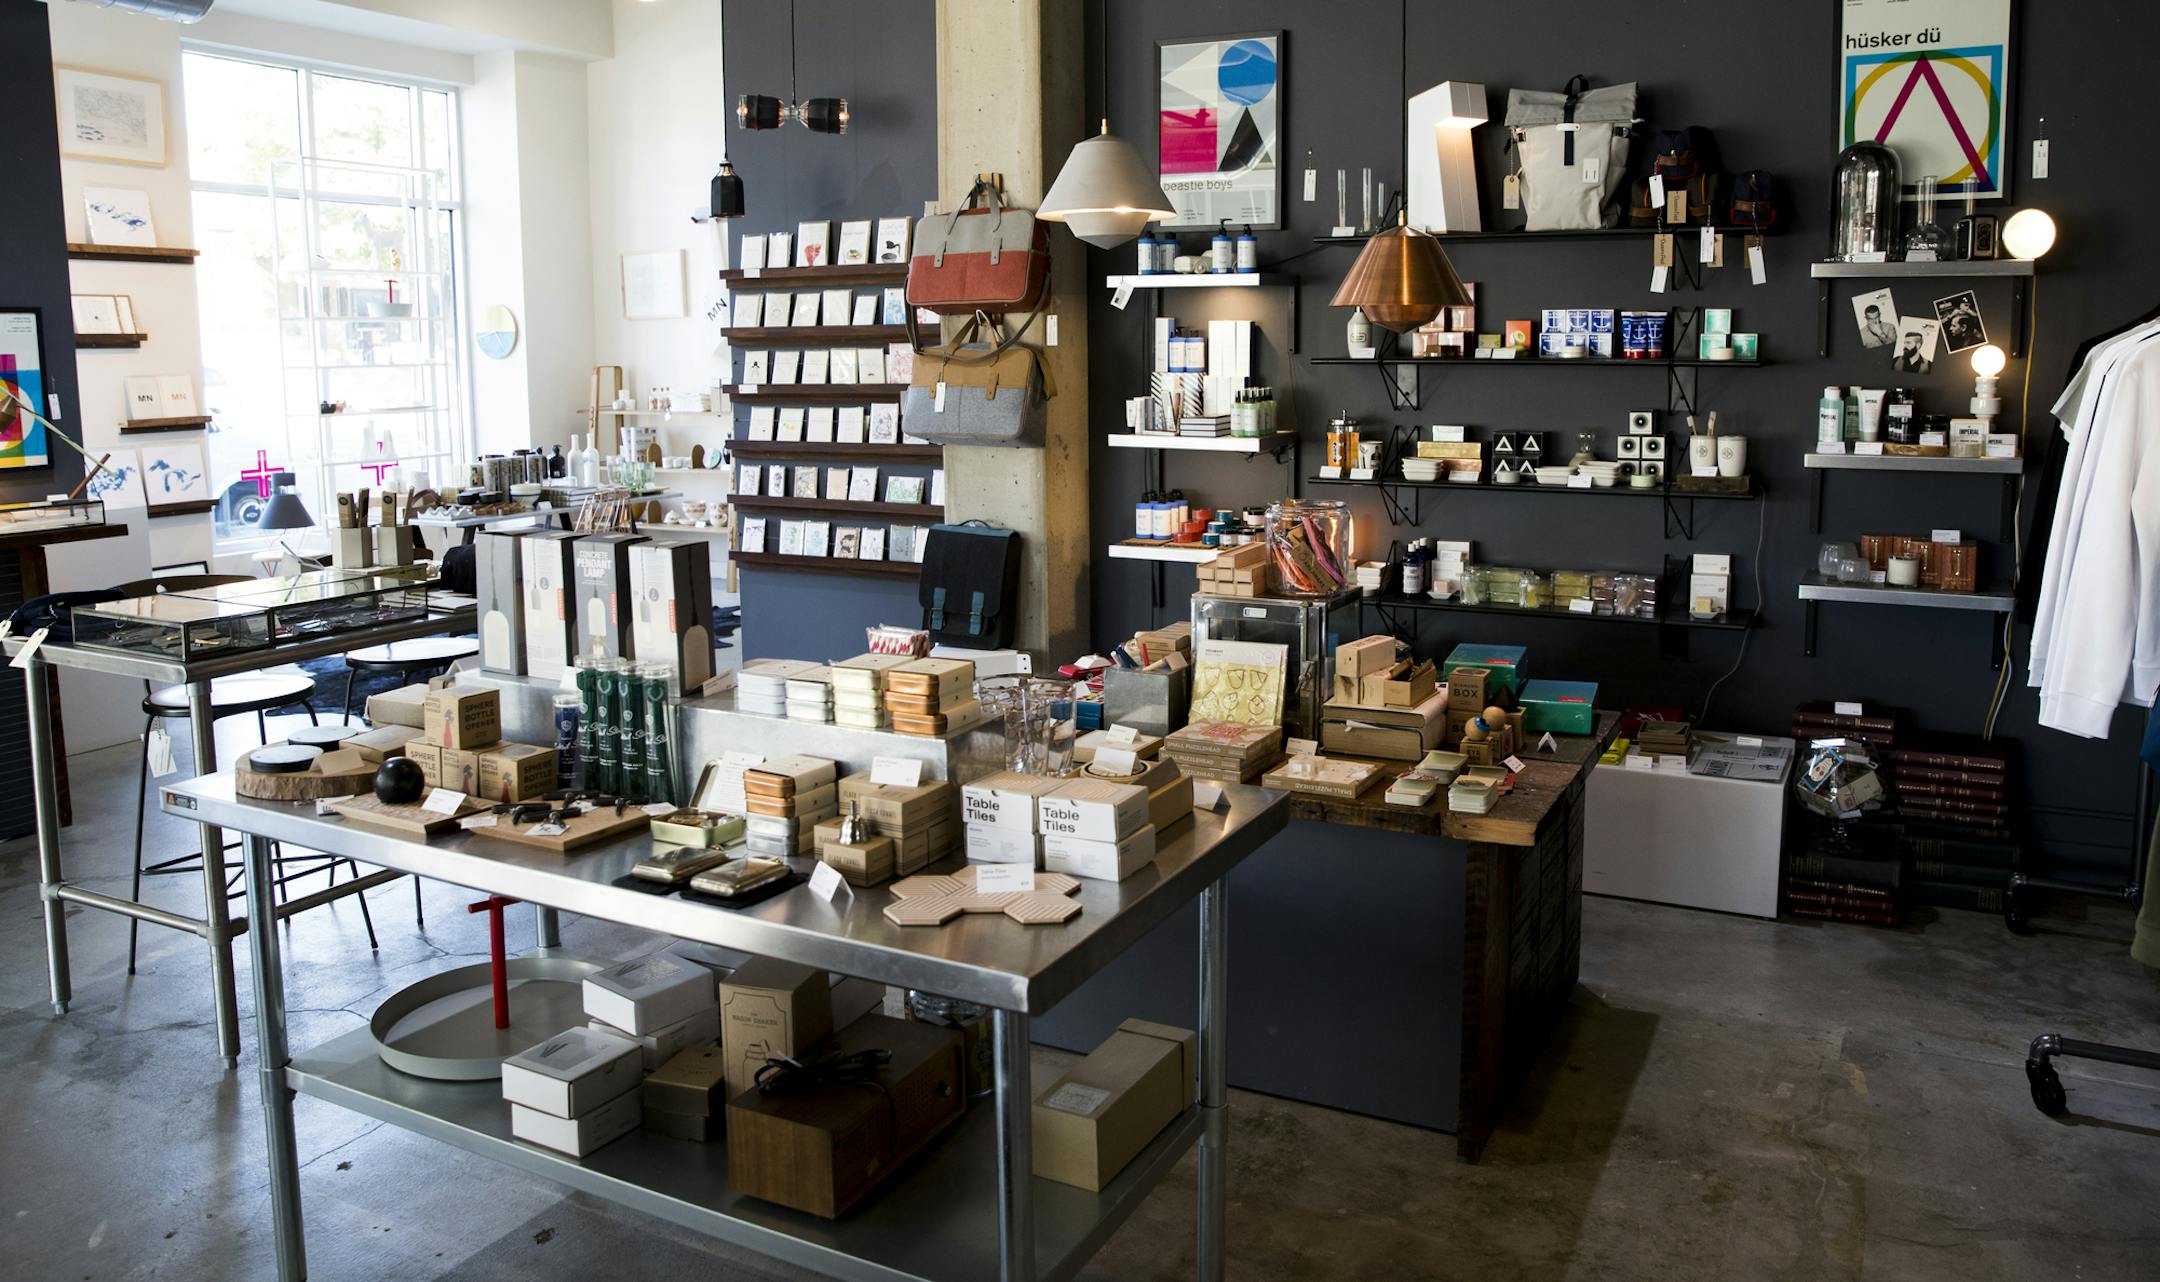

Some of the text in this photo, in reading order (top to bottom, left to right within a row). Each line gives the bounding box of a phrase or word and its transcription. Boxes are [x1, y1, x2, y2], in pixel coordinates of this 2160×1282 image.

[1846, 27, 1940, 49] hüsker dü
[1206, 179, 1233, 191] boys
[577, 558, 612, 570] PENDANT
[583, 567, 607, 578] LAMP
[1454, 689, 1478, 698] BOX
[464, 700, 495, 713] SPHERE
[464, 708, 495, 722] BOTTLE
[465, 718, 495, 731] OPENER
[1185, 743, 1221, 753] PUZZLEHEAD
[411, 750, 436, 761] SPHERE
[523, 768, 553, 785] BOTTLE
[966, 796, 1000, 811] Table
[966, 808, 996, 823] Tiles
[1042, 807, 1080, 821] Table
[1043, 819, 1076, 833] Tiles
